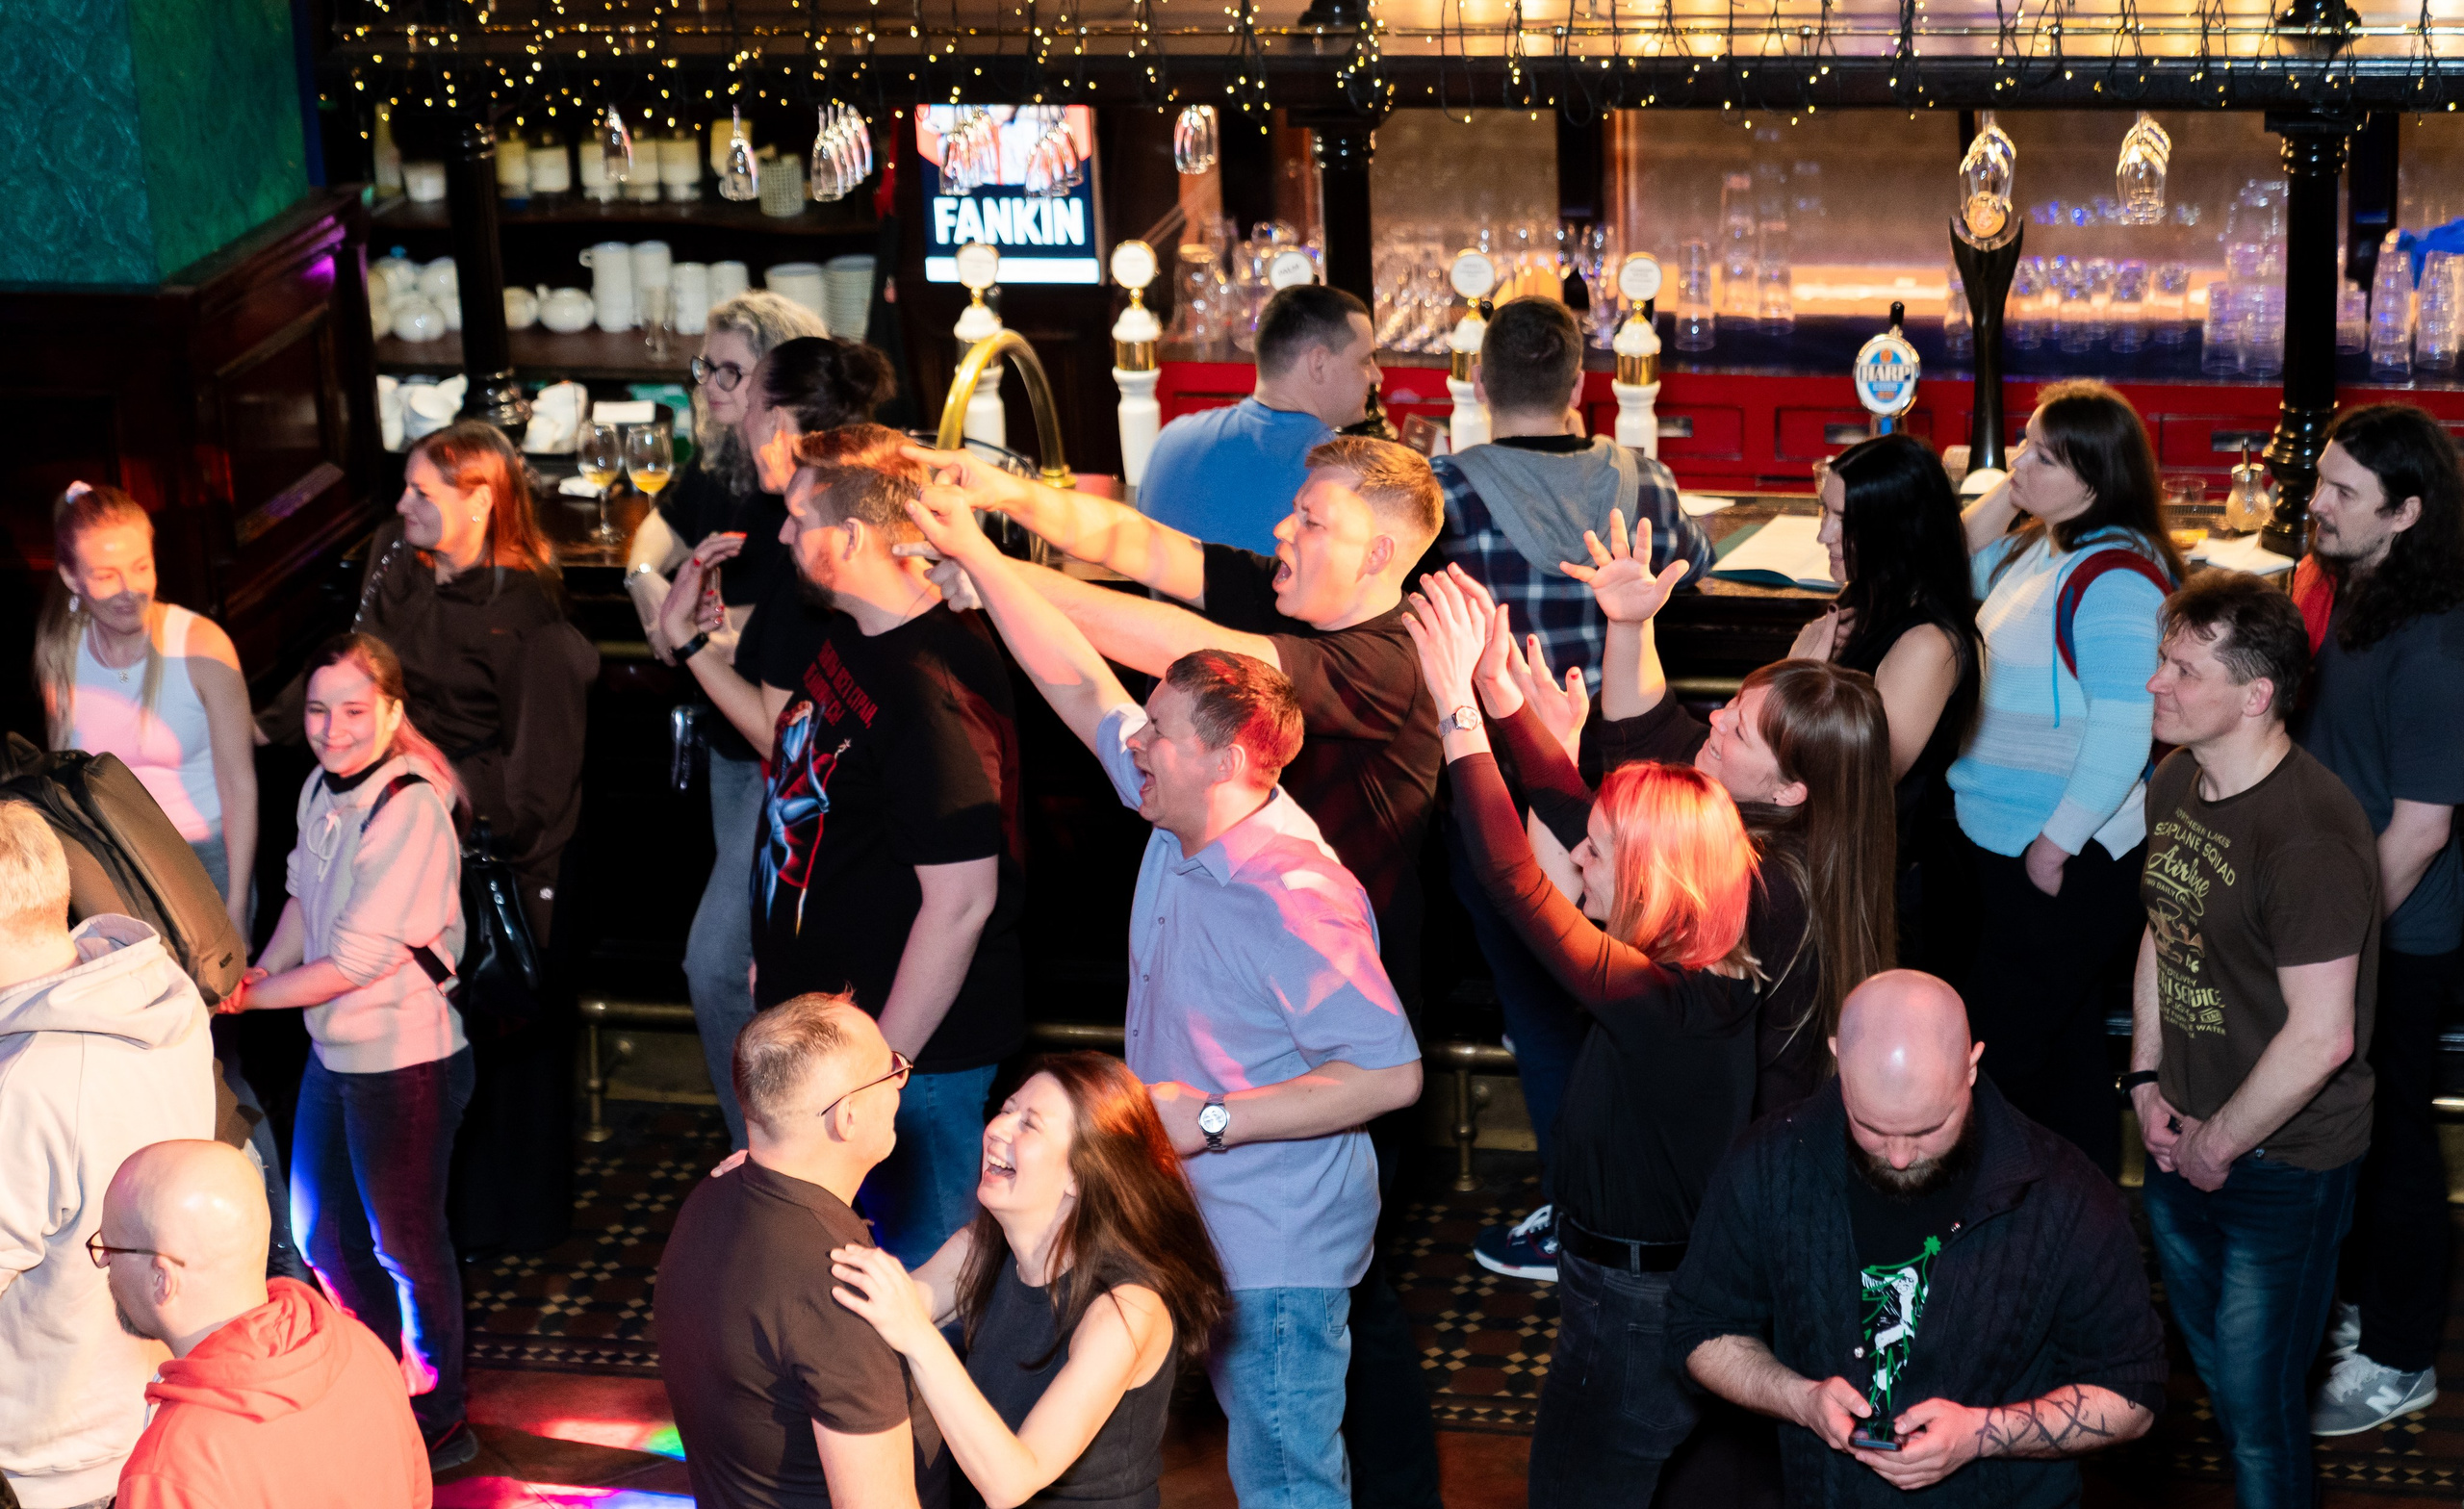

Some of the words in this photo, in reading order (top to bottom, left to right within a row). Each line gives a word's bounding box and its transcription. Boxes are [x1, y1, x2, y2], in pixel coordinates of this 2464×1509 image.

[933, 196, 1086, 245] FANKIN
[1860, 364, 1912, 383] HARP
[2207, 831, 2232, 849] LAKES
[2153, 821, 2202, 853] SEAPLANE
[2202, 842, 2236, 886] SQUAD
[2196, 1024, 2226, 1036] WATER
